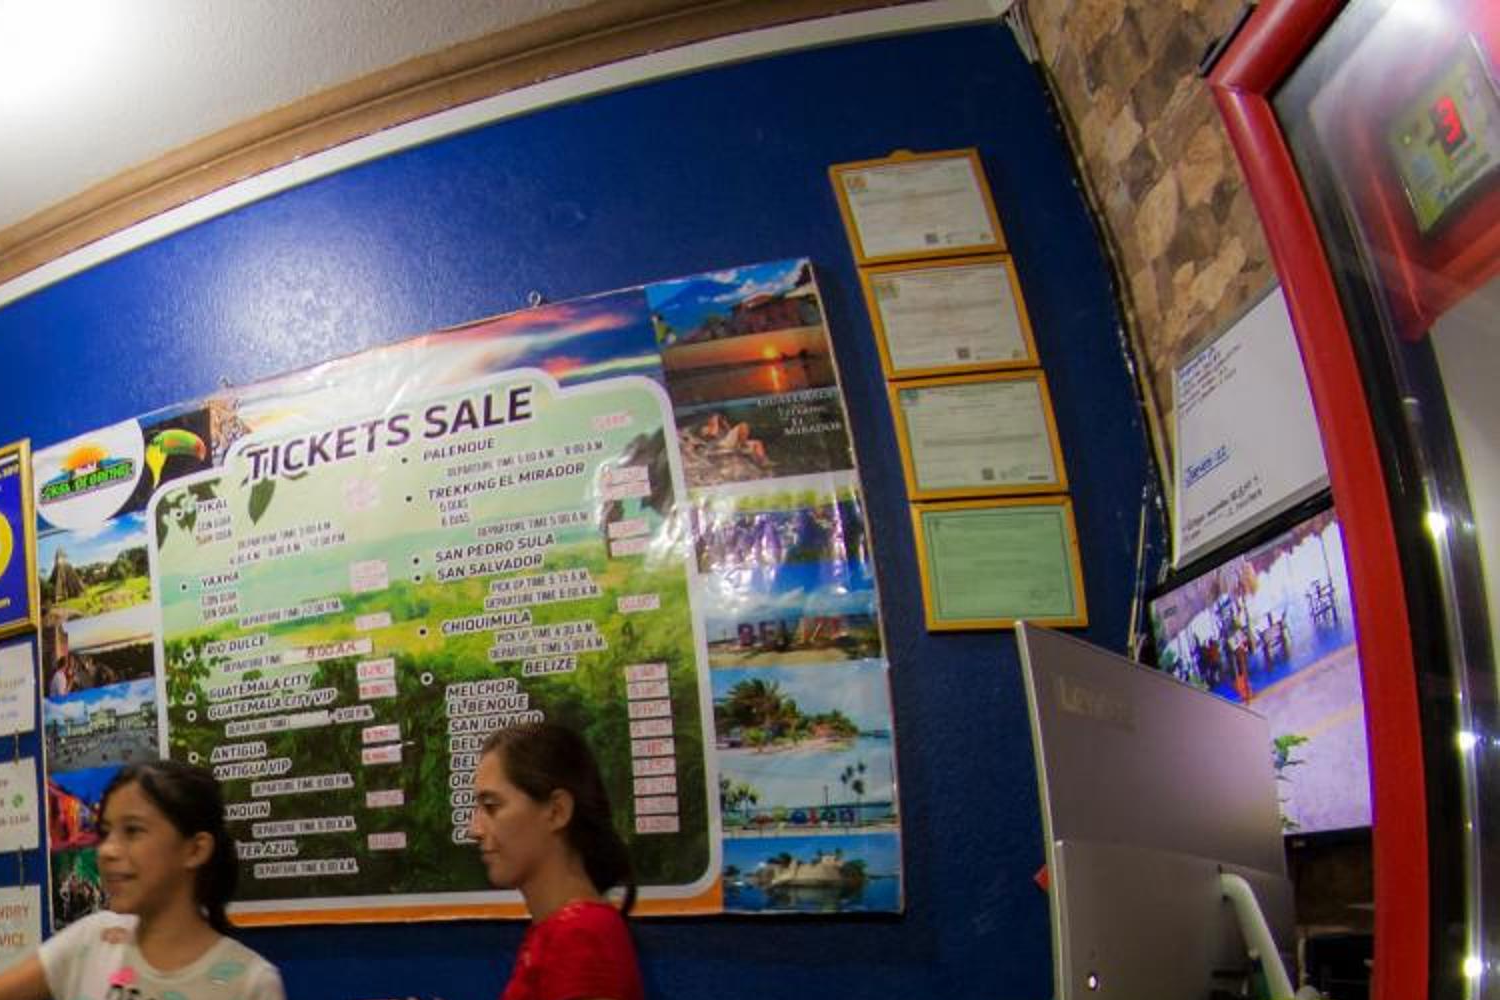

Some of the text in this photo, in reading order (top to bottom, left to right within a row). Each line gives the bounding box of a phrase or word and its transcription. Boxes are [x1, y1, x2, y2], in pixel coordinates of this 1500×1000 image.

[246, 386, 532, 481] TICKETS SALE
[423, 438, 497, 461] PALENQUE
[428, 462, 585, 500] TREKKING EL MIRADOR
[436, 534, 555, 563] SAN PEDRO SULA
[437, 553, 543, 581] SAN SALVADOR
[442, 612, 531, 635] CHIQUIMULA
[229, 636, 266, 651] DULCE
[525, 658, 571, 674] BELIZE
[209, 672, 311, 699] GUATEMALA CITY
[448, 680, 516, 700] MELCHOR
[209, 698, 281, 718] GUATEMALA
[451, 720, 479, 733] SAN
[213, 744, 266, 759] ANTIGUA
[214, 761, 268, 779] ANTIGUA
